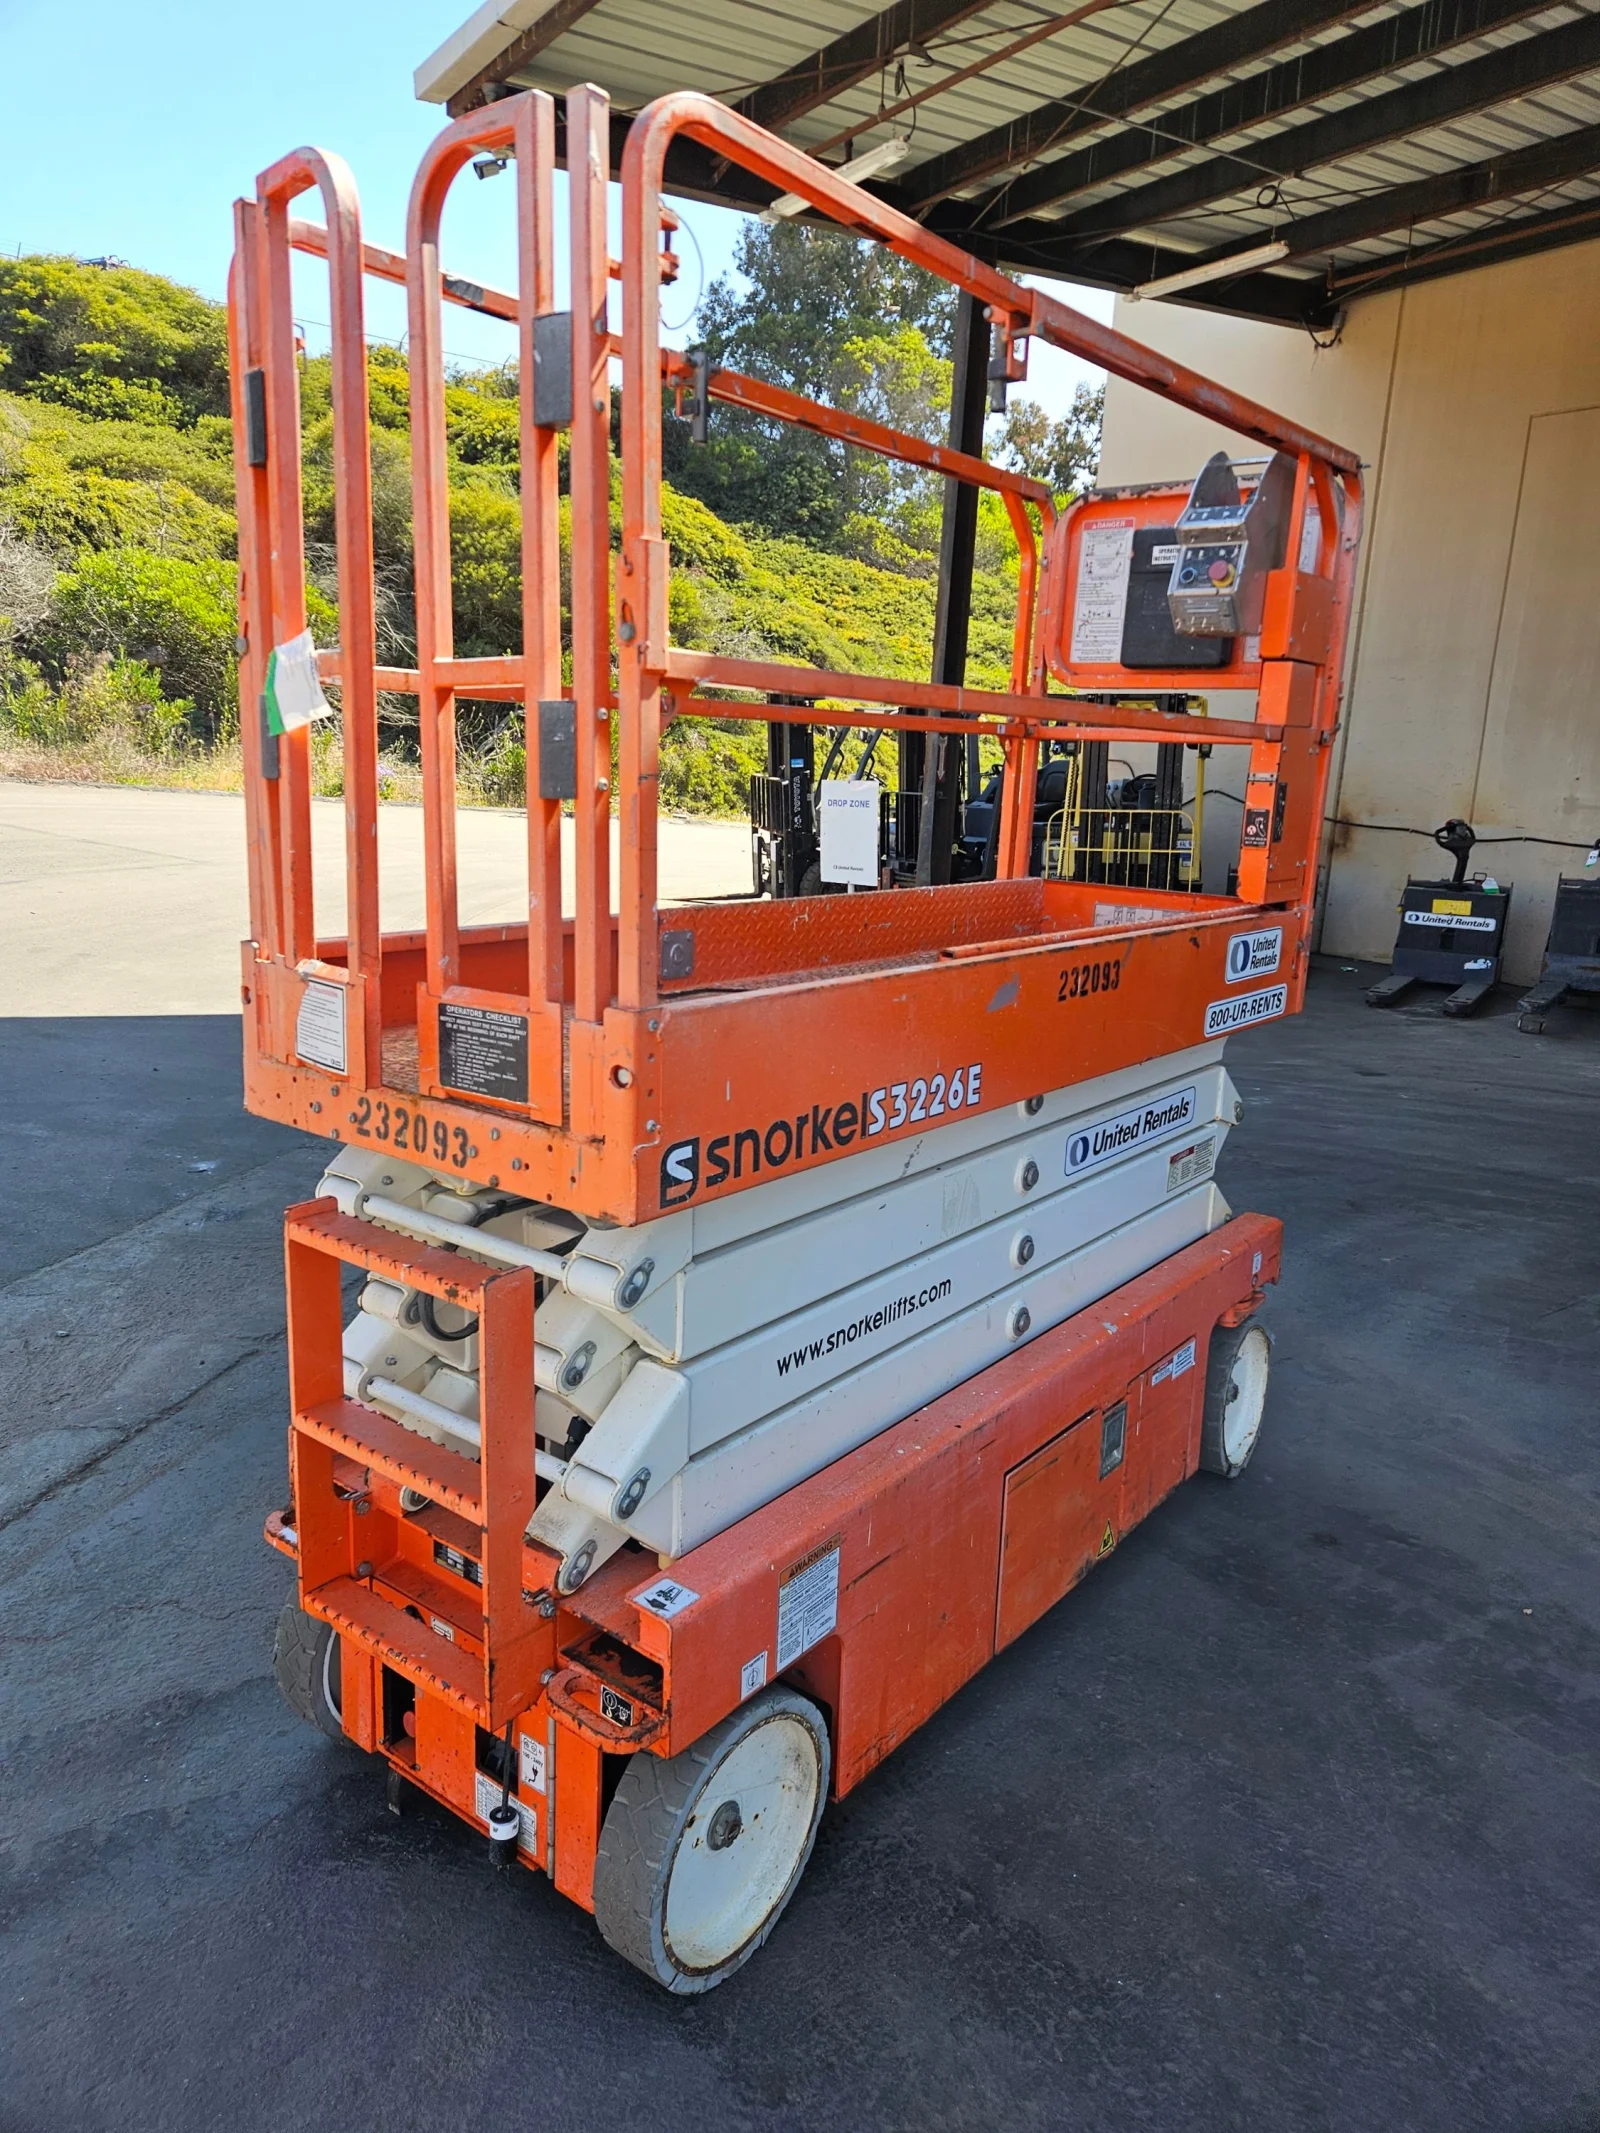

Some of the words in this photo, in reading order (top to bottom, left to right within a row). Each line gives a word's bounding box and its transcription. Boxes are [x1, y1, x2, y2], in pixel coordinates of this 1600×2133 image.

[828, 799, 848, 807] DROP
[849, 800, 870, 808] ZONE
[1422, 915, 1454, 925] United
[1455, 918, 1491, 928] Rentals
[1249, 951, 1278, 970] Rentals
[1252, 934, 1278, 954] United
[1057, 959, 1121, 1002] 232093
[446, 1005, 483, 1018] OPERATORS
[485, 1012, 522, 1025] CHECKLIST
[1208, 991, 1284, 1029] 800-UR-RENTS
[357, 1097, 468, 1168] 232093
[705, 1092, 868, 1188] snorkel
[867, 1063, 982, 1136] S3226E
[1092, 1114, 1142, 1156] United
[1142, 1096, 1190, 1136] Rentals
[776, 1278, 952, 1377] www.snorkellifts.com
[794, 1540, 833, 1574] WARNING
